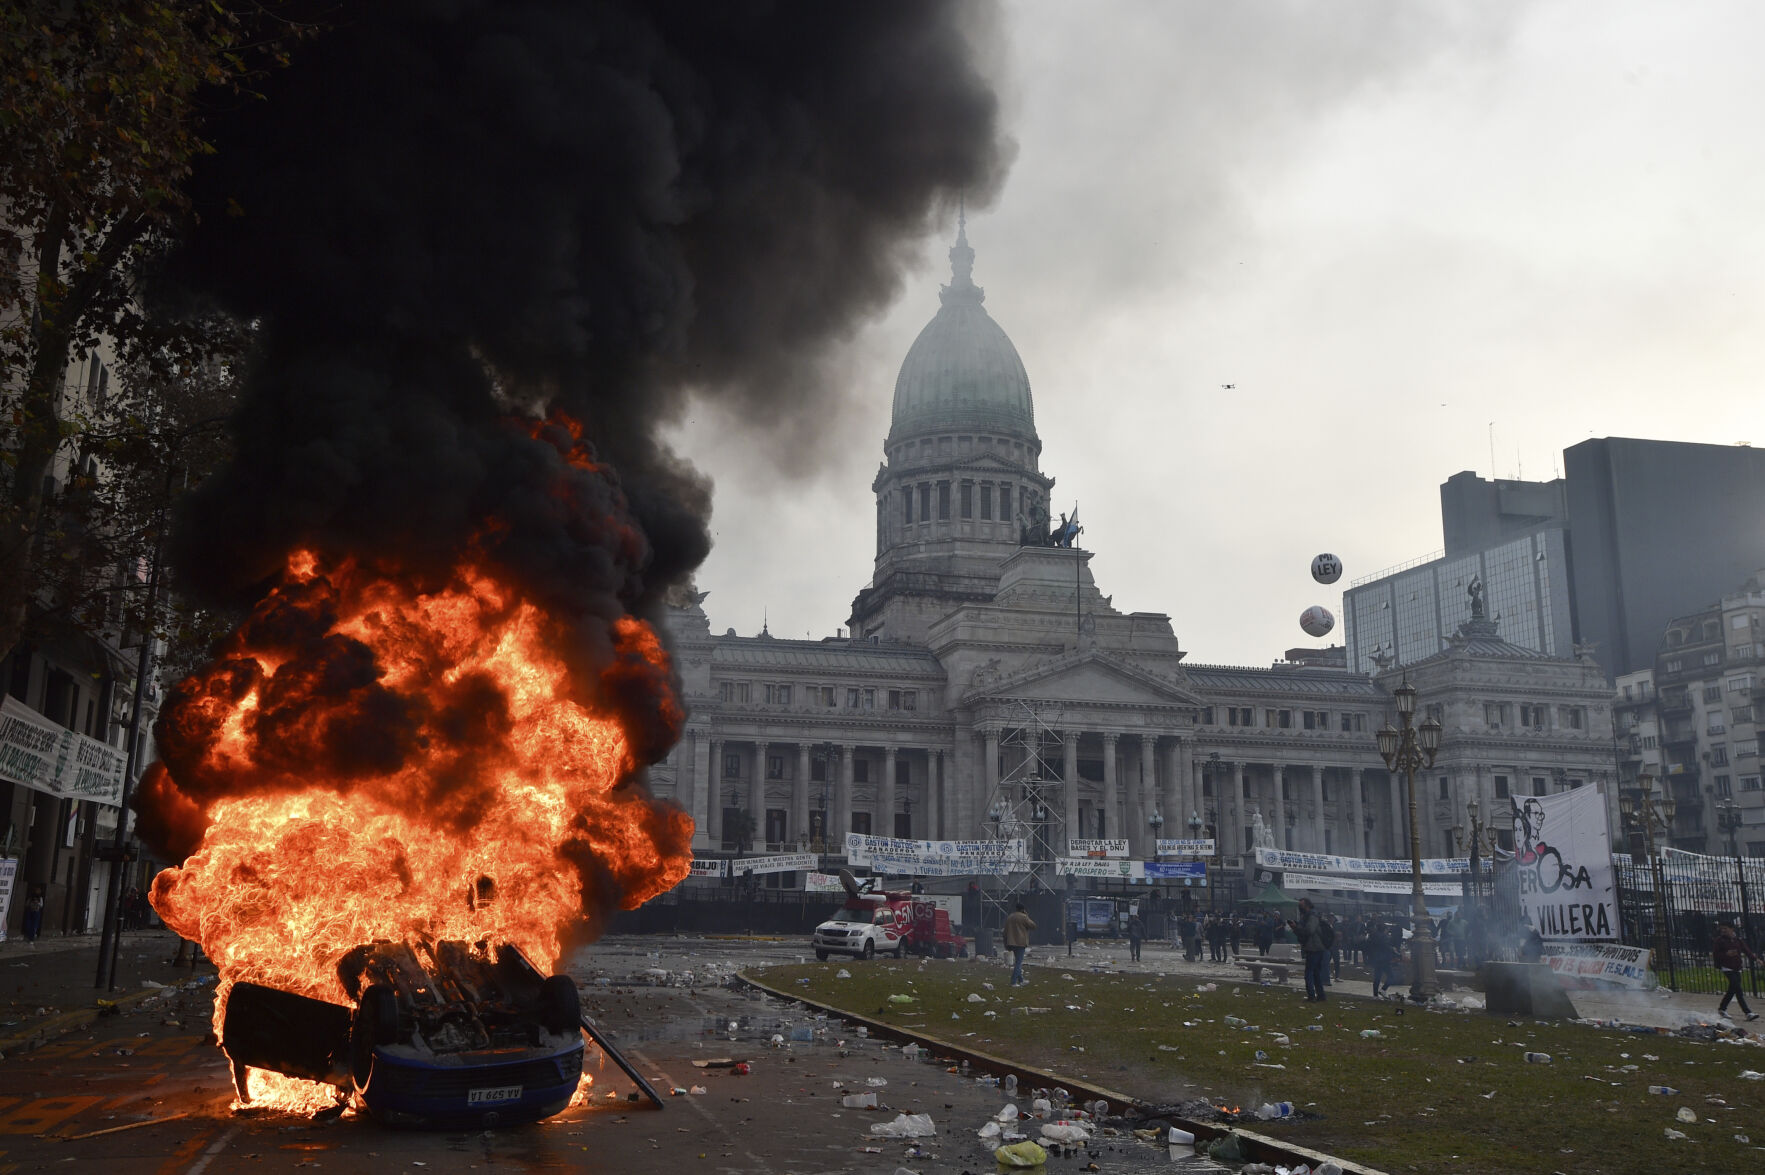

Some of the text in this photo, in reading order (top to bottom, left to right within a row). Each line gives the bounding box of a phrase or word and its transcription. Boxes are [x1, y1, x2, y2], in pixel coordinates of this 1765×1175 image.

[1317, 563, 1336, 575] LEY
[865, 839, 889, 847] GASTON
[956, 844, 980, 852] GASTON
[1073, 867, 1108, 876] PROSPERO
[894, 901, 914, 929] C5N
[1536, 902, 1611, 937] VILLERA
